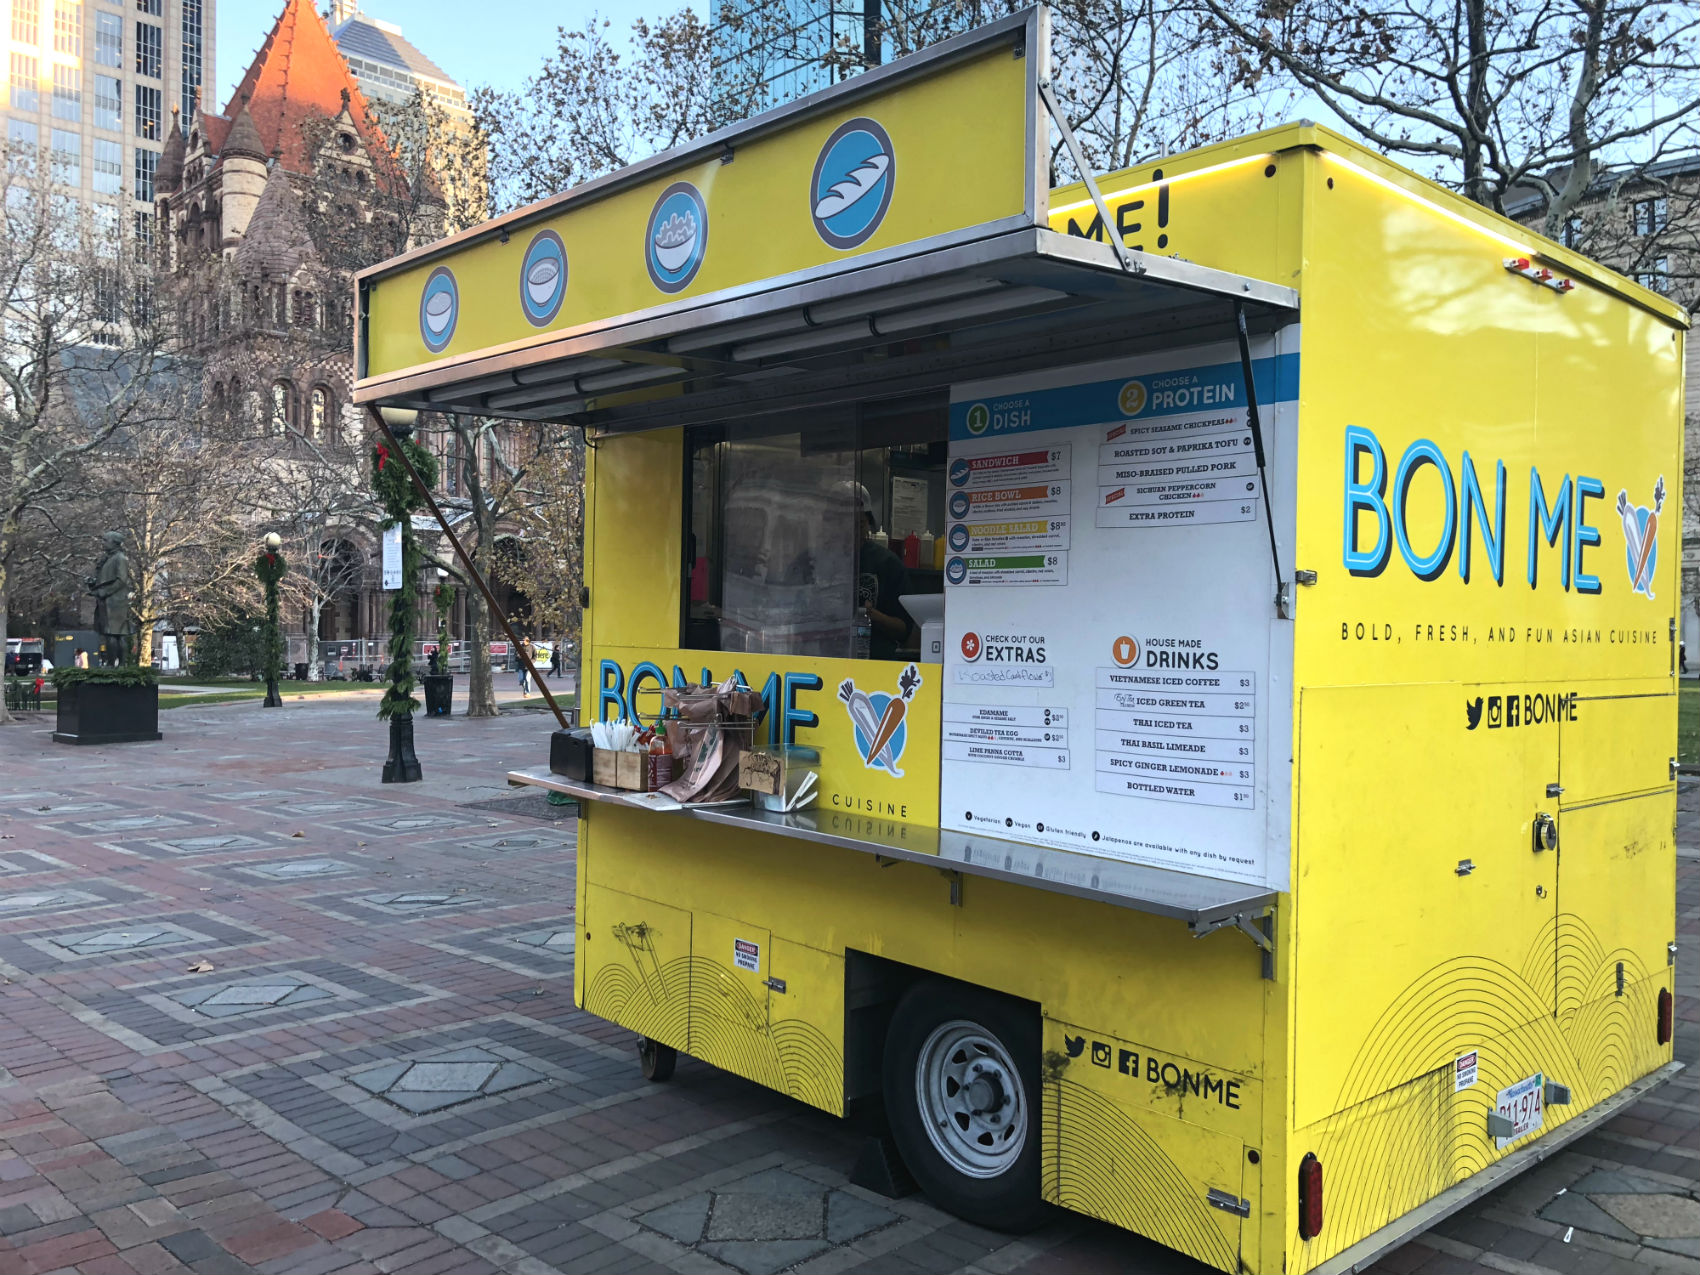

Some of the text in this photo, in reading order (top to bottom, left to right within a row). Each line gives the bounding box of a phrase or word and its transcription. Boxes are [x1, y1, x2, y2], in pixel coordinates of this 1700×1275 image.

[1152, 376, 1198, 388] CHOOSE A
[1152, 383, 1235, 410] PROTEIN
[993, 400, 1022, 411] CHOOSE
[993, 410, 1031, 430] DISH
[1130, 426, 1150, 435] SPICY
[1184, 418, 1224, 430] CHICKPEAS
[1114, 449, 1149, 457] ROASTED
[1152, 447, 1167, 455] SOY
[1178, 441, 1213, 452] PAPRIKA
[1215, 439, 1238, 448] TOFU
[972, 456, 1019, 468] SANDWICH
[1051, 451, 1061, 461] $7
[1116, 462, 1236, 479] MISO-BRAISED PULLED PORK
[1051, 486, 1061, 496] $8
[1168, 483, 1216, 492] PEPPERCORN
[972, 490, 1022, 502] RICE BOWL
[1129, 510, 1195, 520] EXTRA PROTEIN
[1343, 424, 1605, 595] BON ME
[971, 523, 1038, 535] NOODLE SALAD
[969, 559, 996, 568] SALAD
[1048, 557, 1058, 566] $8
[1342, 622, 1656, 644] BOLD, FRESH, AND FUN ASIAN CUISINE
[985, 635, 1009, 643] CHECK
[1029, 636, 1045, 644] OUR
[1146, 639, 1201, 648] HOUSE MADE
[985, 646, 1046, 663] EXTRAS
[1146, 650, 1219, 670] DRINKS
[1110, 675, 1160, 684] VIETNAMESE
[1240, 679, 1250, 687] $3
[1159, 699, 1188, 707] GREEN
[1525, 692, 1578, 725] BONME
[1239, 725, 1249, 733] $3
[1121, 739, 1206, 752] THAI BASIL LIMEADE
[1110, 759, 1218, 776] SPICY GINGER LEMONADE
[1240, 771, 1249, 779] $3
[1127, 782, 1195, 796] BOTTLED WATER
[832, 794, 907, 817] CUISINE
[974, 815, 1001, 824] Vegetarian
[1065, 829, 1087, 839] friendly
[1102, 835, 1132, 845] Jalapenos
[1145, 842, 1172, 852] available
[1218, 853, 1227, 861] by
[1229, 856, 1255, 865] request
[1147, 1057, 1240, 1109] BONME
